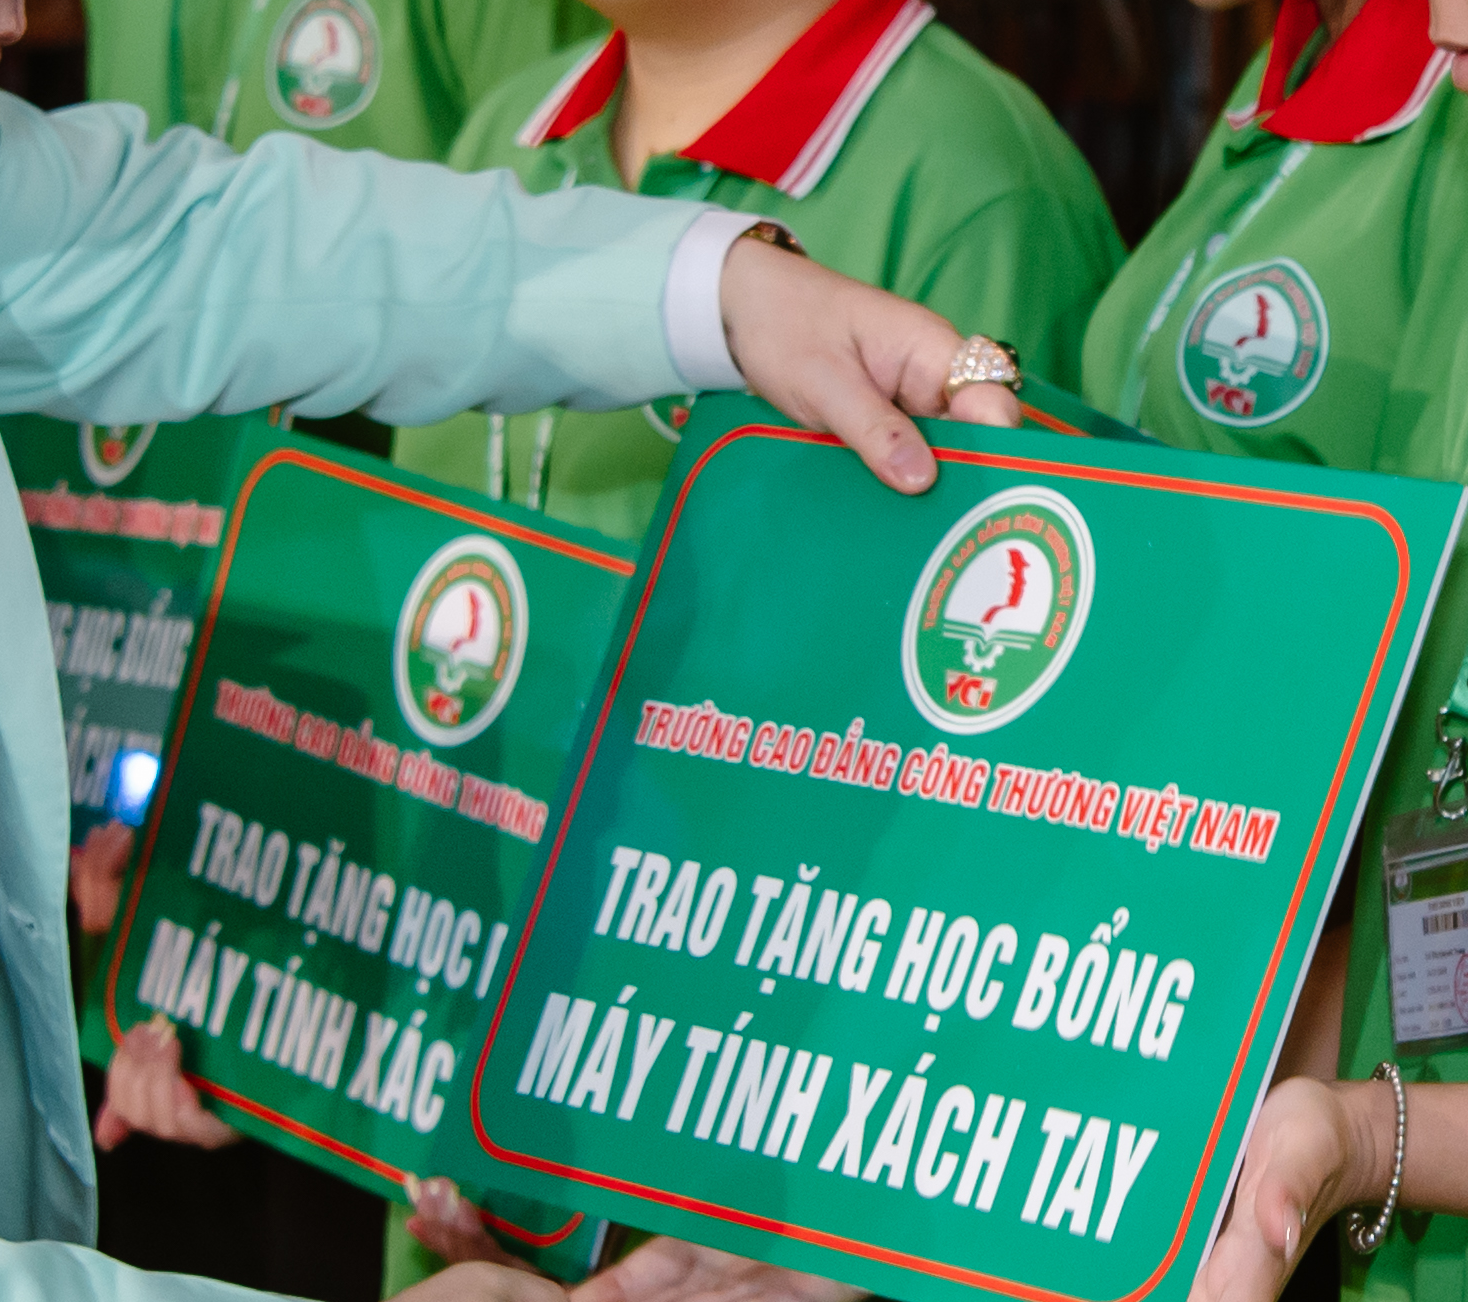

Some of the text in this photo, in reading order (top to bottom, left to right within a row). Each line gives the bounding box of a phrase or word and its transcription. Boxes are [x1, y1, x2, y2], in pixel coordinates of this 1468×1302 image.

[634, 699, 1281, 865] TRƯỜNG CAO ĐẲNG CÔNG THƯƠNG VIỆT NAM
[189, 800, 290, 908] TRAO
[286, 837, 397, 954] TẶNG
[388, 886, 483, 996] HỌC
[594, 844, 1196, 1062] TRAO TẶNG HỌC BỔNG
[137, 917, 250, 1038] MÁY
[240, 954, 358, 1090] TÍNH
[345, 1007, 458, 1134] XÁC
[515, 984, 1160, 1245] MÁY TÍNH XÁCH TAY
